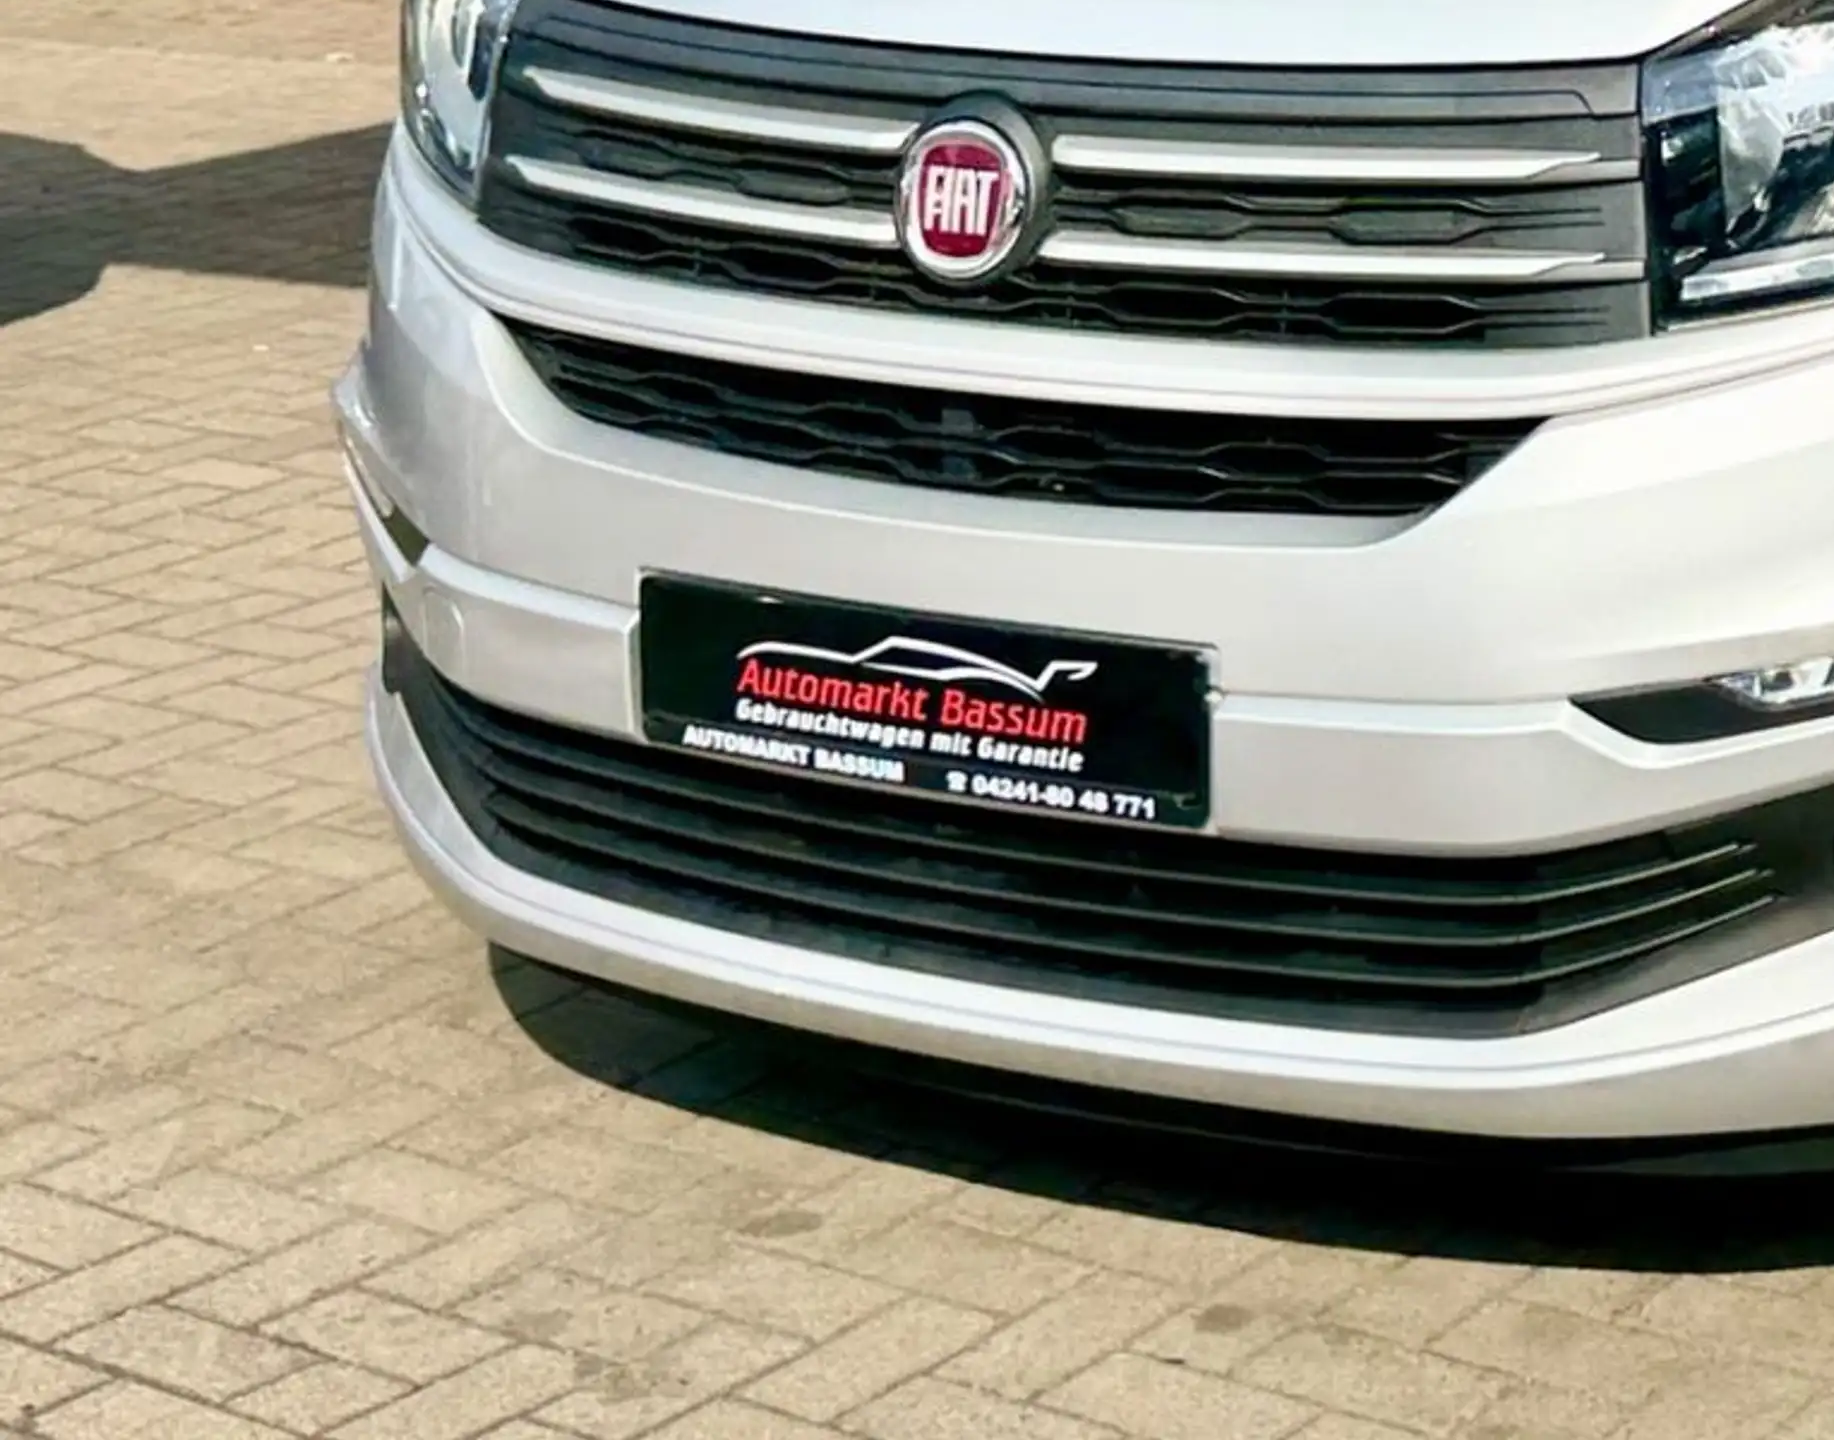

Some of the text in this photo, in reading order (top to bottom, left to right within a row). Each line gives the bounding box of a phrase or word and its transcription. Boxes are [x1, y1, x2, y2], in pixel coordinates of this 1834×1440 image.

[924, 164, 999, 236] FIAT
[735, 697, 1086, 773] Gebrauchtwagen mit Garantie
[737, 658, 1088, 744] Automarkt Bassum
[682, 724, 906, 782] AUTOMARKT BASSUM
[1111, 792, 1157, 821] 771
